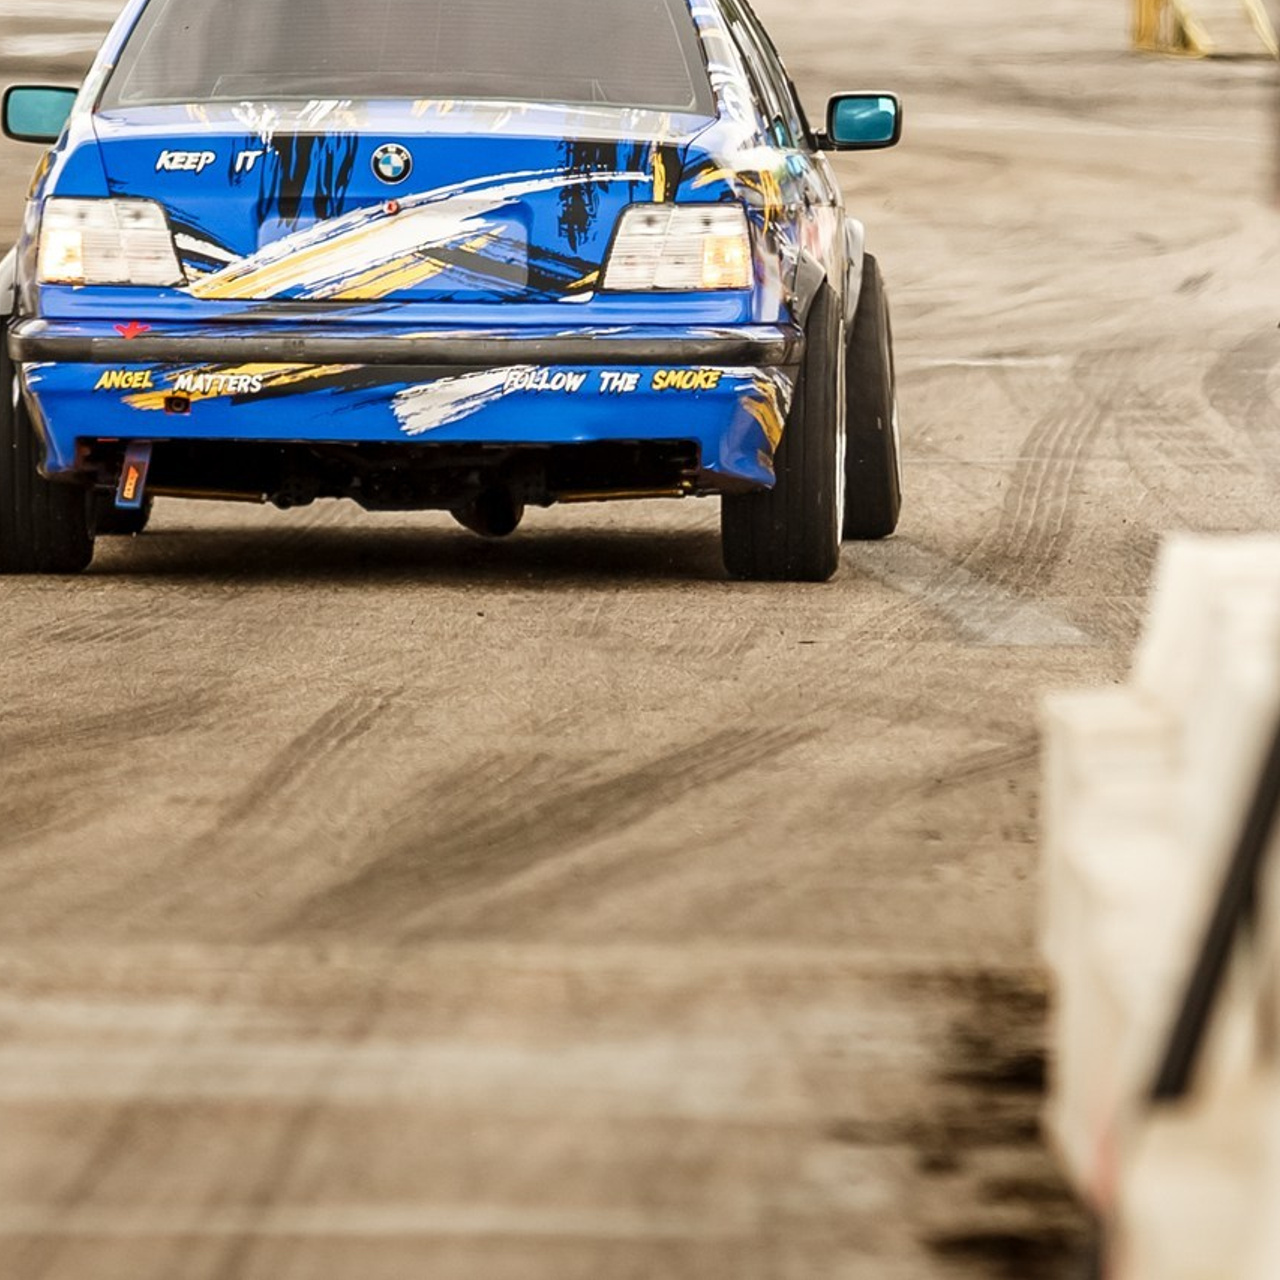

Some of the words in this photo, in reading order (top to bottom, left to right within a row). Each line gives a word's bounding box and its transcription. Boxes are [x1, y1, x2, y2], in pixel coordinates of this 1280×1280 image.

[156, 150, 215, 173] KEEP
[235, 150, 264, 172] IT
[94, 370, 153, 390] ANGEL
[174, 373, 263, 394] MATTERS
[502, 370, 586, 392] FOLLOW
[599, 371, 640, 393] THE
[651, 369, 722, 391] SMOKE
